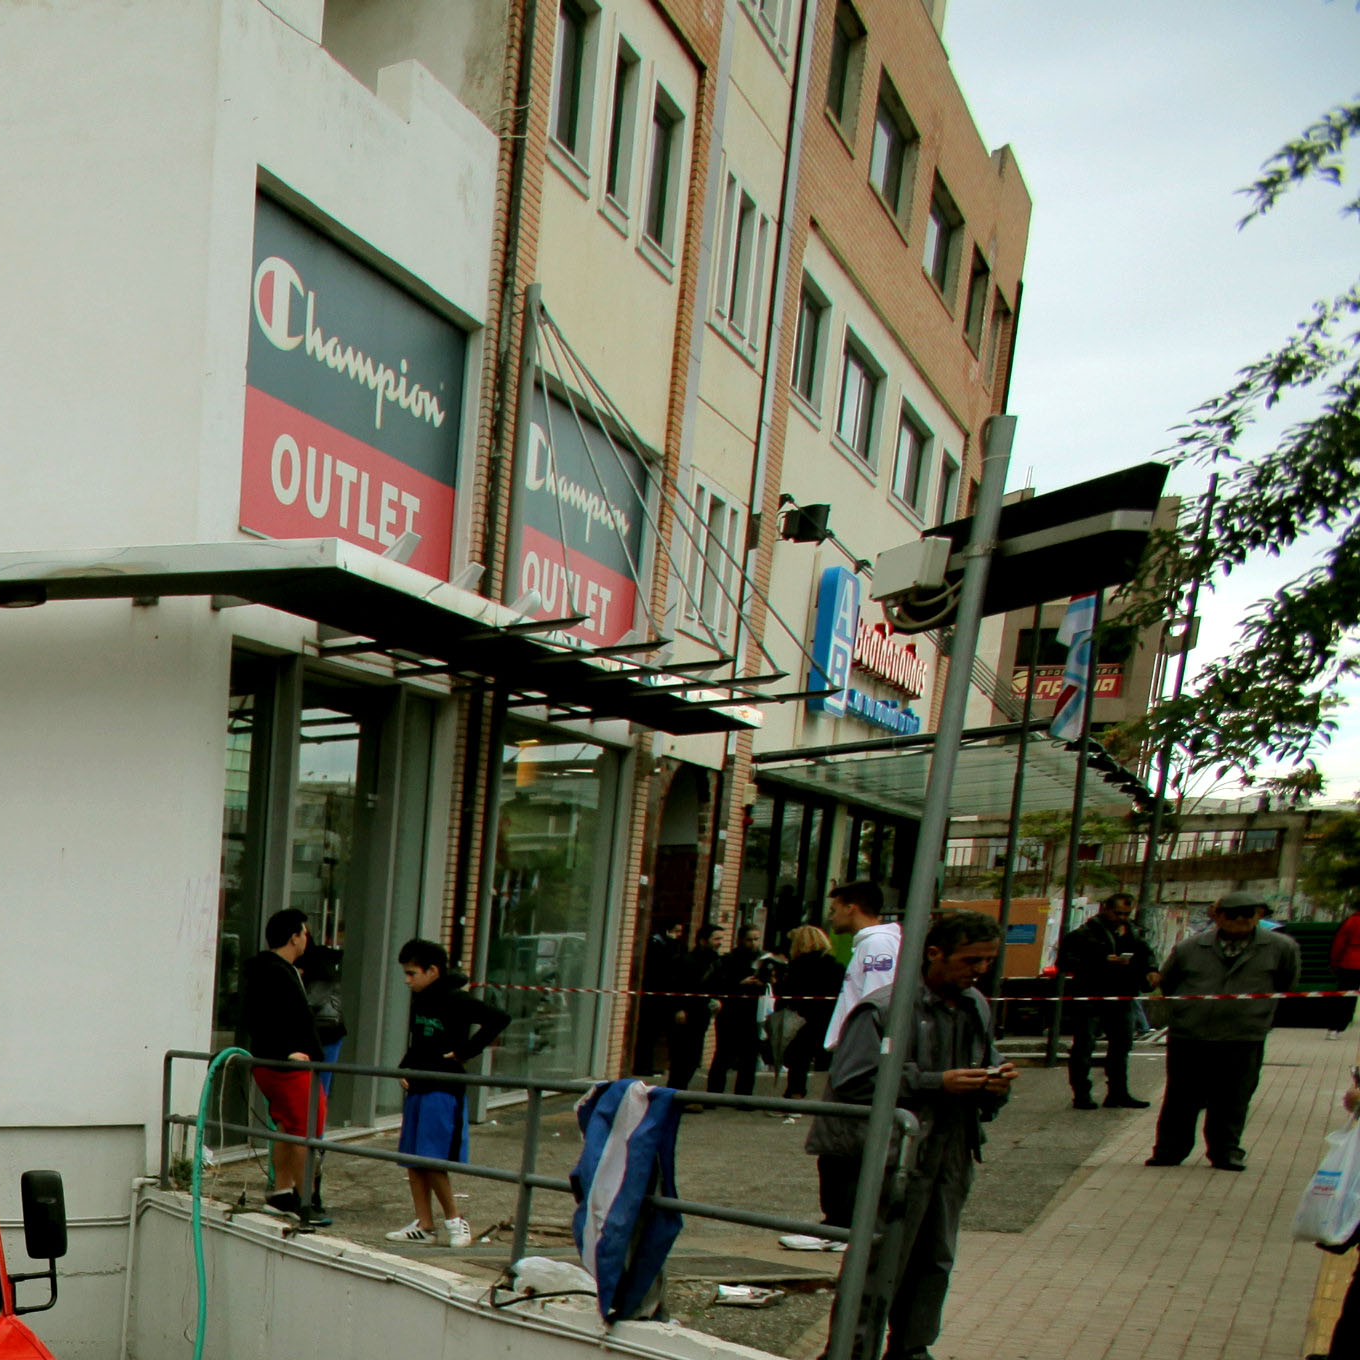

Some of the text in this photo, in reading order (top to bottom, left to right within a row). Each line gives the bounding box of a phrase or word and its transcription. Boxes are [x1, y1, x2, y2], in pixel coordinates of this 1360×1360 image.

[254, 256, 446, 430] Champion
[270, 433, 421, 549] OUTLET
[521, 550, 612, 636] OUTLET
